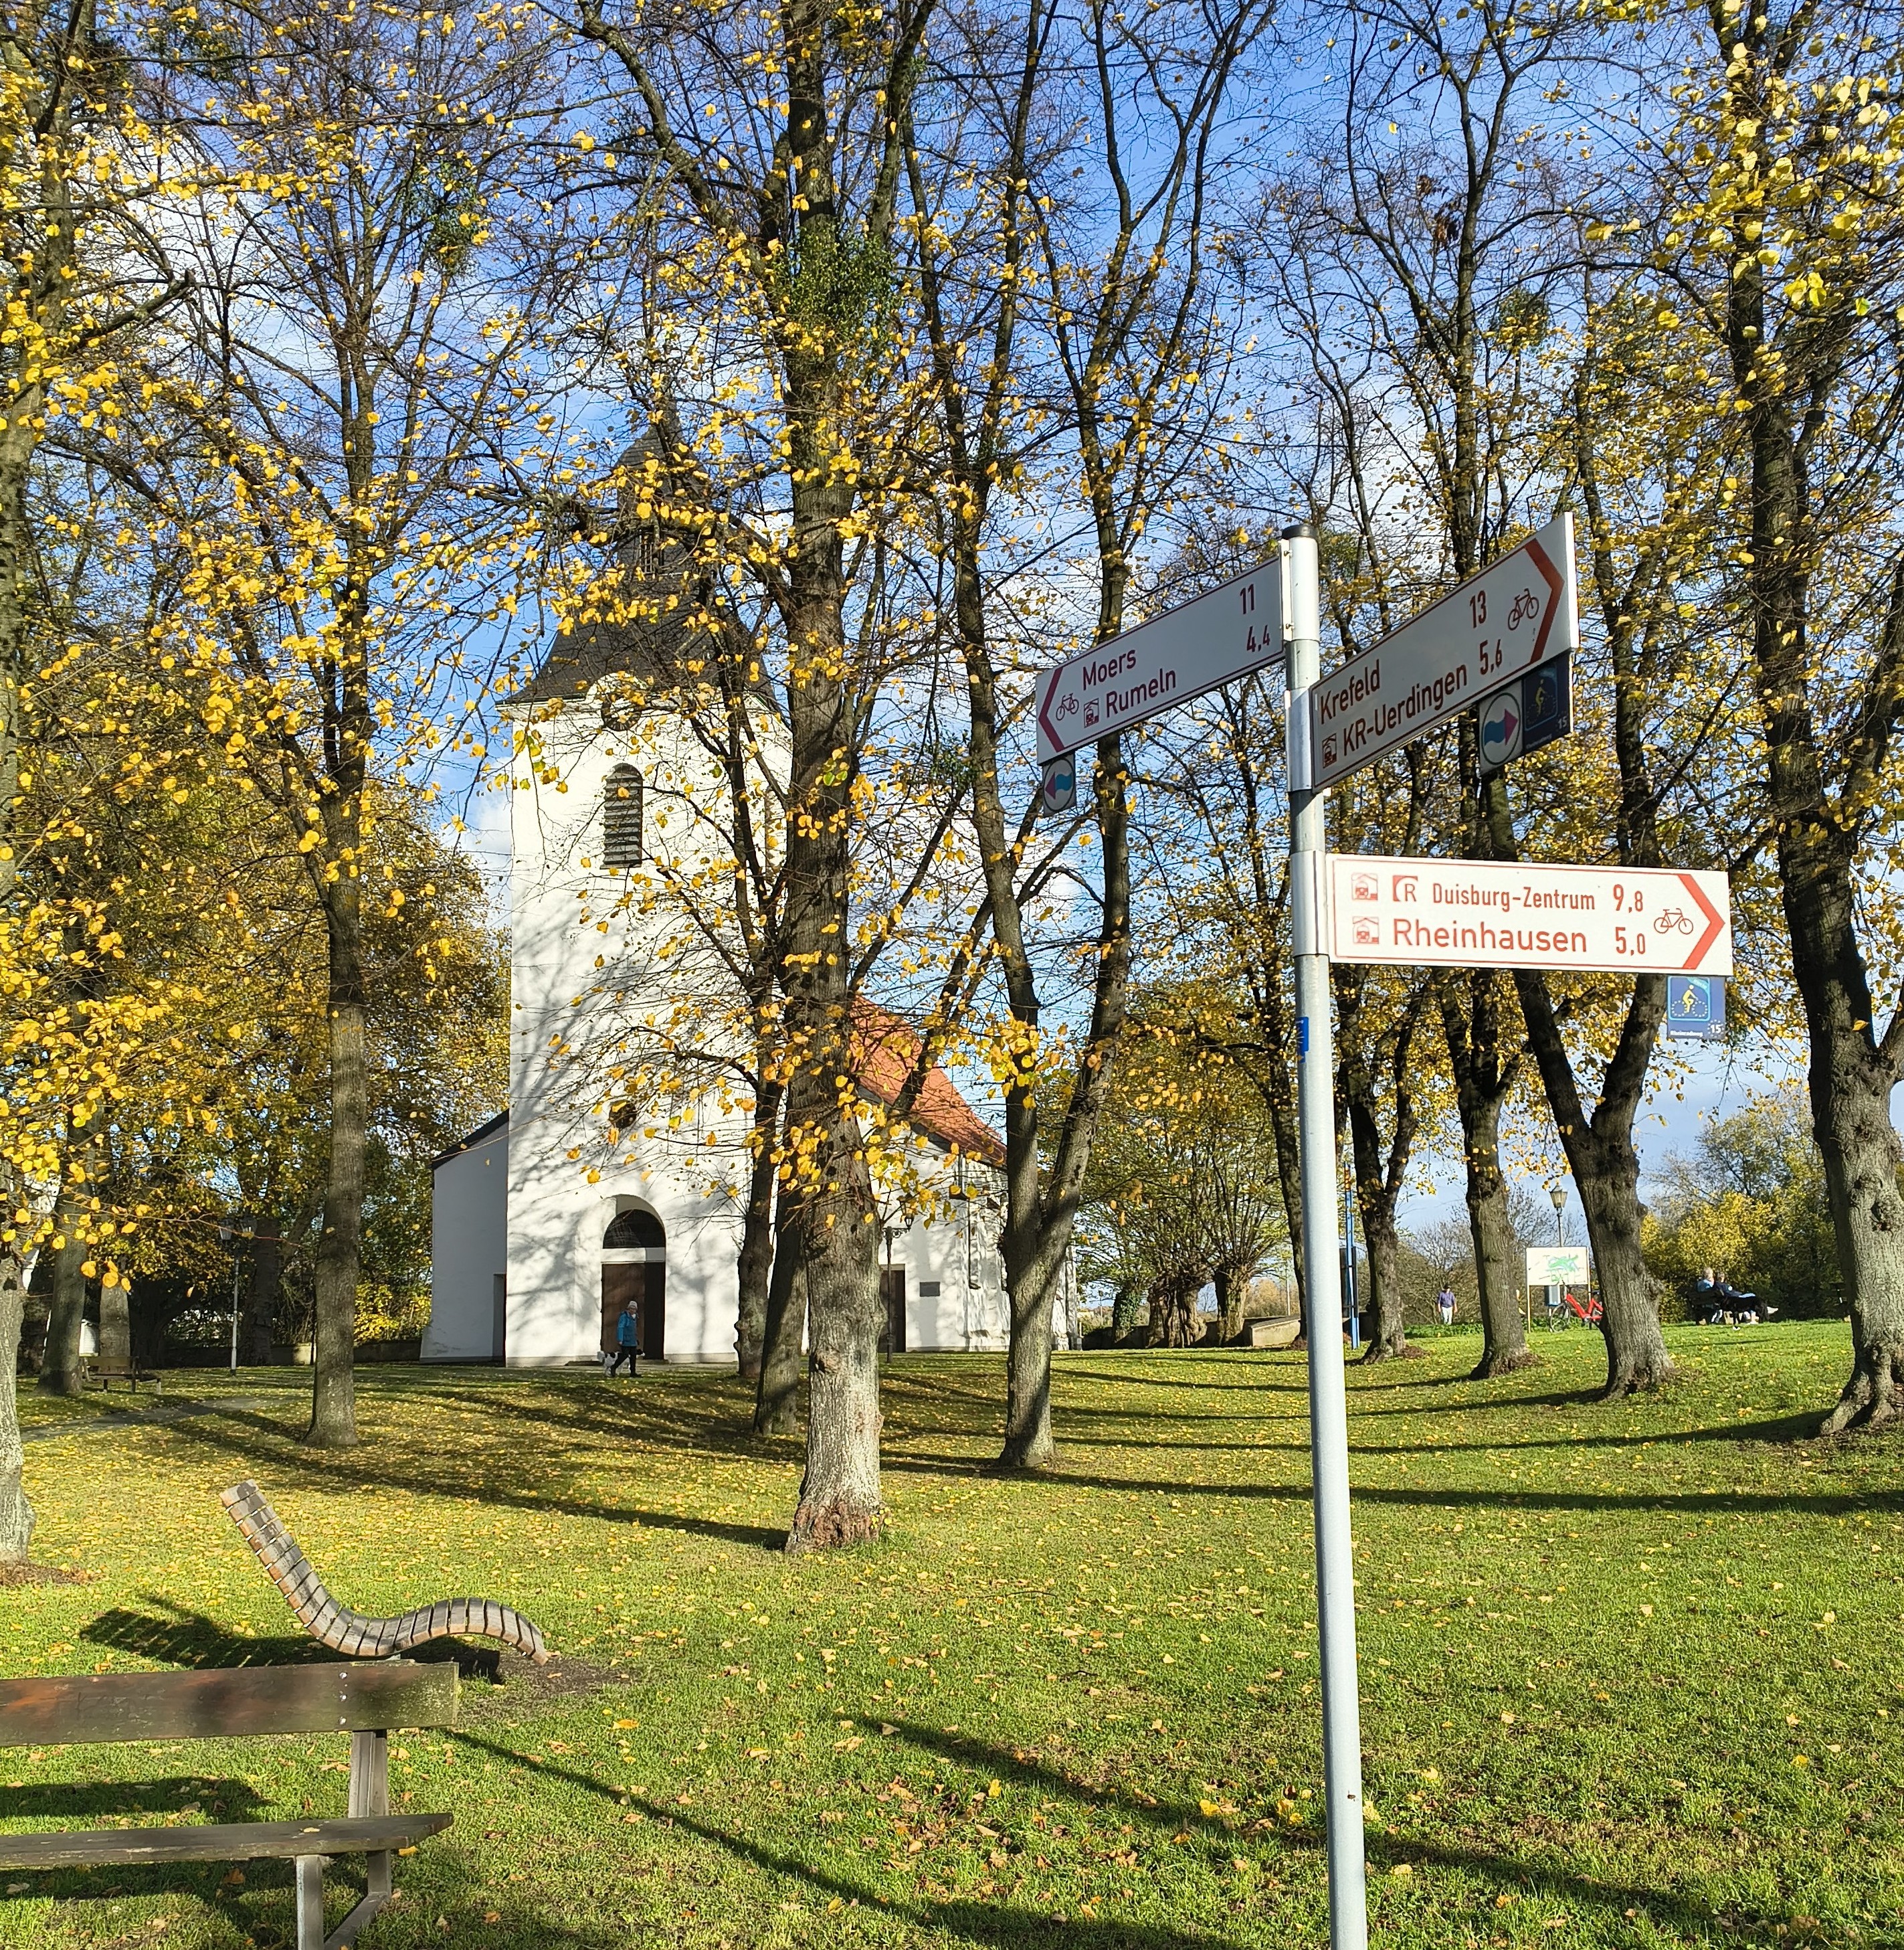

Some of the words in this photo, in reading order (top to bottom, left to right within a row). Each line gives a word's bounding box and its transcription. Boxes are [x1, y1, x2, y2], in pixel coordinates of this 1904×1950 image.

[1082, 648, 1136, 690] Moers
[1239, 583, 1255, 614] 11
[1106, 668, 1176, 717] Rumeln
[1246, 624, 1270, 652] 4,4
[1320, 659, 1380, 724] Krefeld
[1469, 590, 1487, 628] 13
[1343, 664, 1466, 756] KR-Uerdingen
[1479, 638, 1503, 676] 5,6
[1393, 918, 1587, 952] Rheinhausen
[1615, 927, 1646, 956] 5,0
[1433, 883, 1595, 912] Duisburg-Zentrum
[1613, 884, 1643, 913] 9,8
[1710, 1024, 1721, 1034] 15
